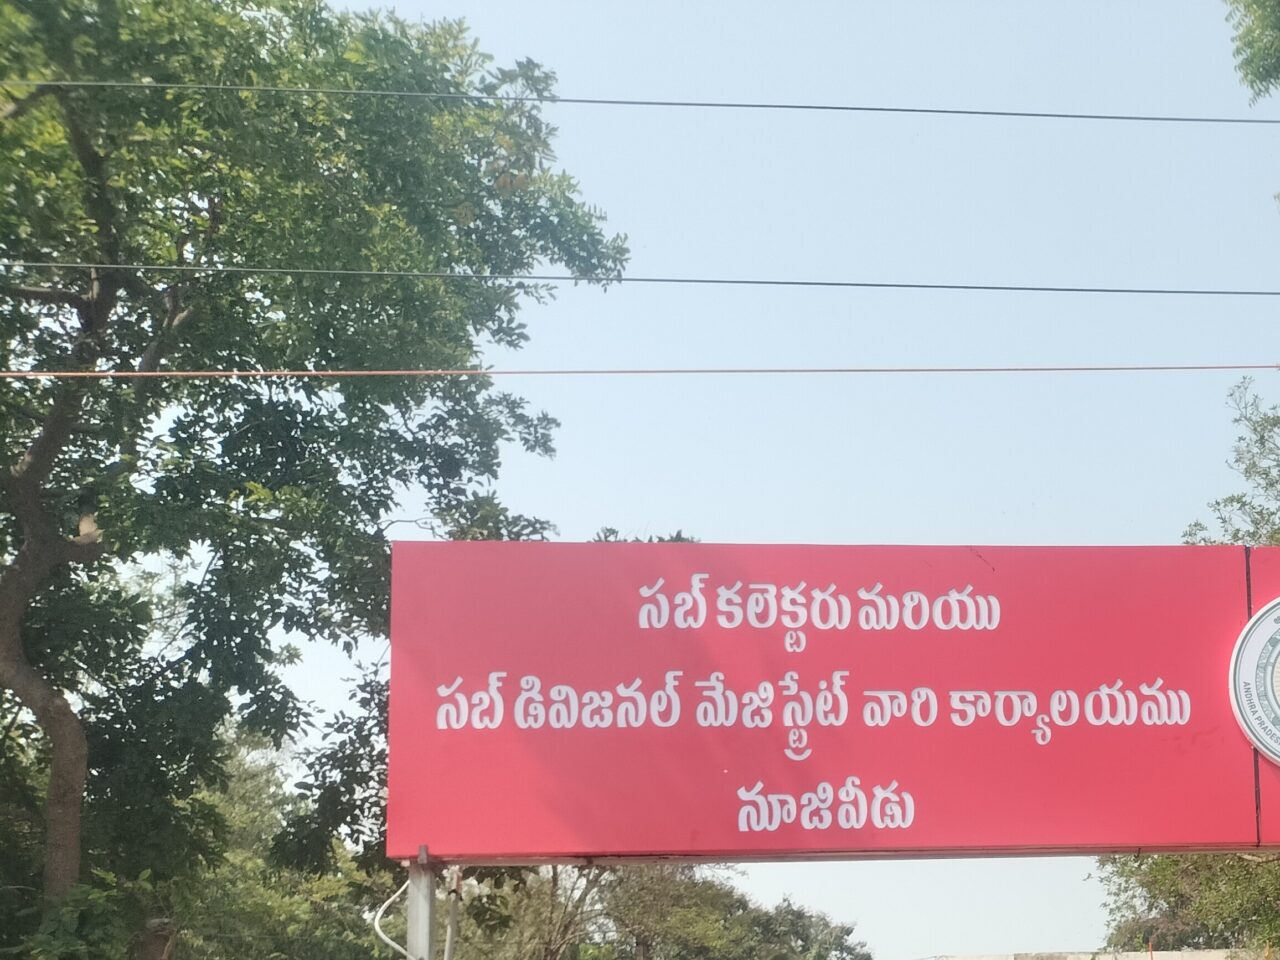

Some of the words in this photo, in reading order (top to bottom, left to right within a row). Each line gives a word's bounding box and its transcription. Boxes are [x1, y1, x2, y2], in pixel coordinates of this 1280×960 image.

[638, 573, 710, 629] సబ్
[716, 580, 852, 653] కలెక్టరు
[856, 582, 1001, 631] మరియు
[436, 671, 508, 730] సబ్
[513, 670, 684, 729] డివిజనల్
[694, 670, 850, 761] మేజిస్ట్రేట్
[862, 687, 938, 727] వారి
[949, 677, 1191, 745] కార్యాలయము
[1243, 681, 1259, 716] ANDHRA
[736, 775, 915, 832] నూజివీడు
